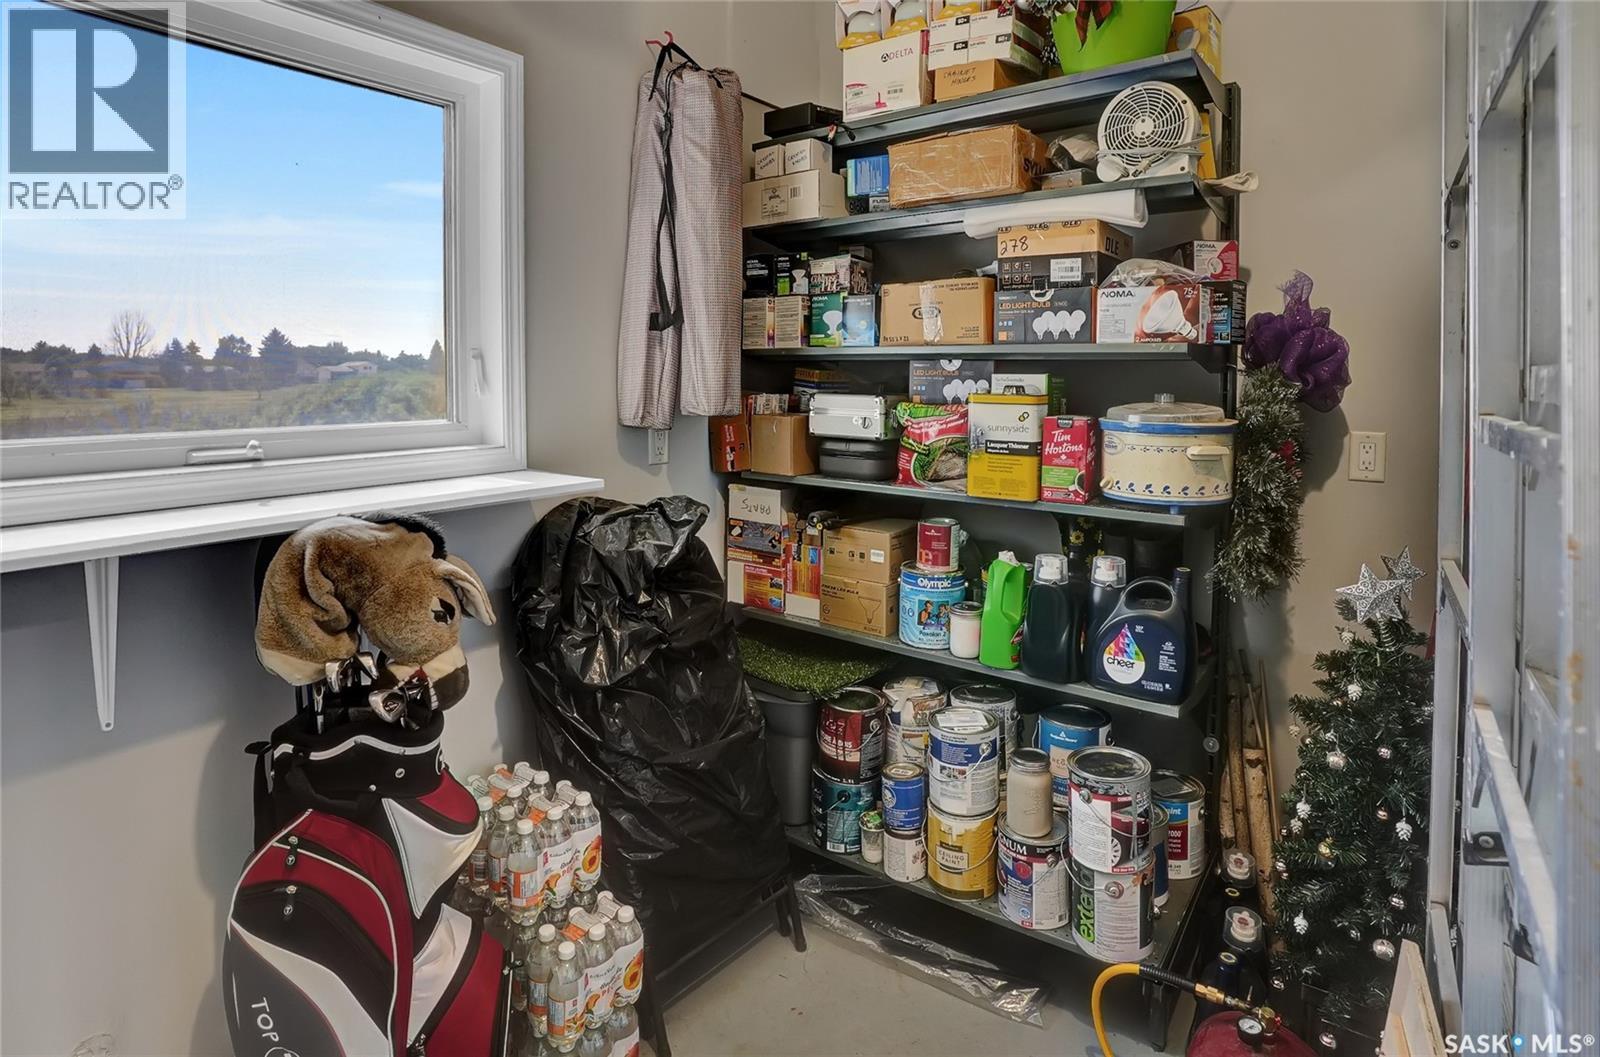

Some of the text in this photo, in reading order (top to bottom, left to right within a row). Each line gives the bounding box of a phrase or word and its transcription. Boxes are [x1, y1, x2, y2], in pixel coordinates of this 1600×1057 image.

[889, 47, 914, 60] DELTA
[1000, 235, 1029, 256] 278
[1105, 236, 1120, 256] DLE
[1100, 290, 1134, 298] NOMA
[1011, 301, 1031, 309] LIGHT
[986, 424, 1030, 433] sunnyside
[1051, 429, 1071, 443] Tim
[1045, 442, 1084, 456] Hortons
[741, 498, 771, 515] PARTS
[917, 577, 951, 589] Olympic
[1106, 656, 1136, 669] cheer
[938, 850, 964, 861] CEILING
[942, 856, 960, 865] PAINT
[251, 997, 280, 1042] TOP
